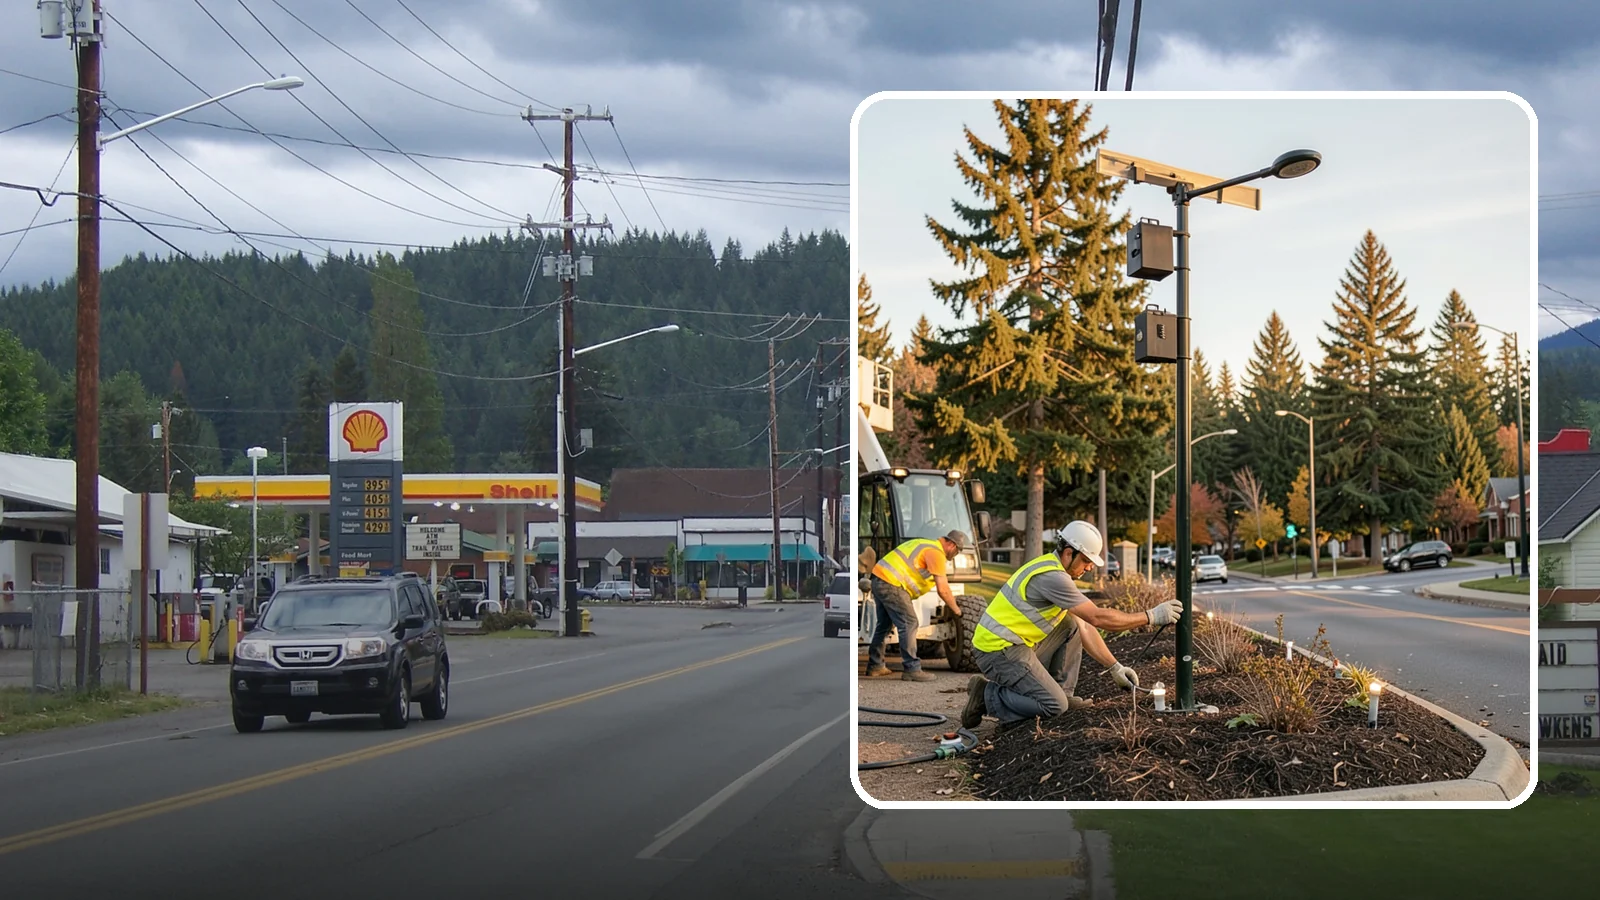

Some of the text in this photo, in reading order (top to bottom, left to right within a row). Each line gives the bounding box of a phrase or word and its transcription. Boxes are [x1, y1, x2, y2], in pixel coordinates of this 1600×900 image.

[366, 480, 383, 490] 395
[490, 484, 547, 499] Shell
[366, 494, 383, 504] 405
[366, 508, 383, 518] 415
[366, 522, 383, 533] 429
